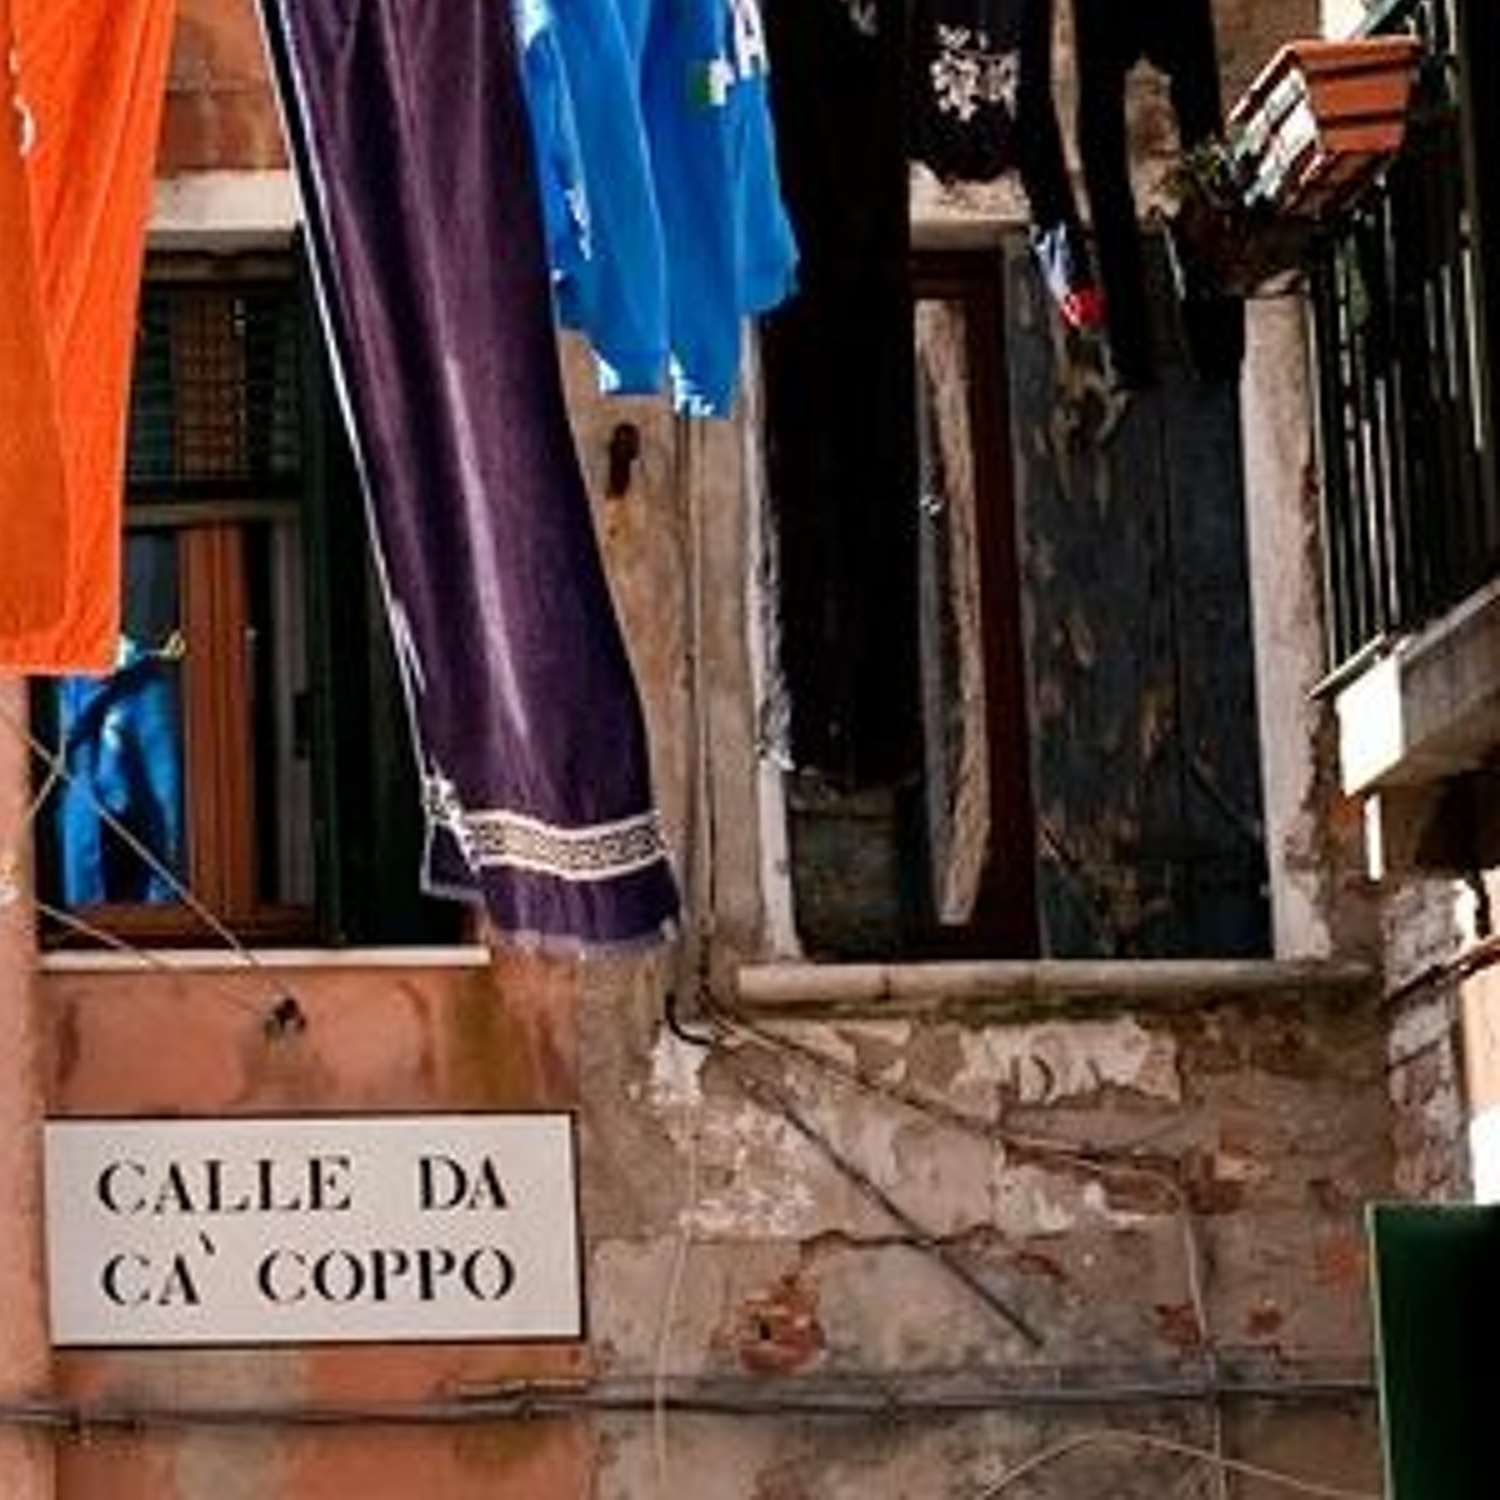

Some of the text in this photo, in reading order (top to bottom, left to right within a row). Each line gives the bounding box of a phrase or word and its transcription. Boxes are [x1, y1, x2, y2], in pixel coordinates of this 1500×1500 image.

[96, 1156, 508, 1214] CALLE DA
[257, 1248, 516, 1302] COPPO
